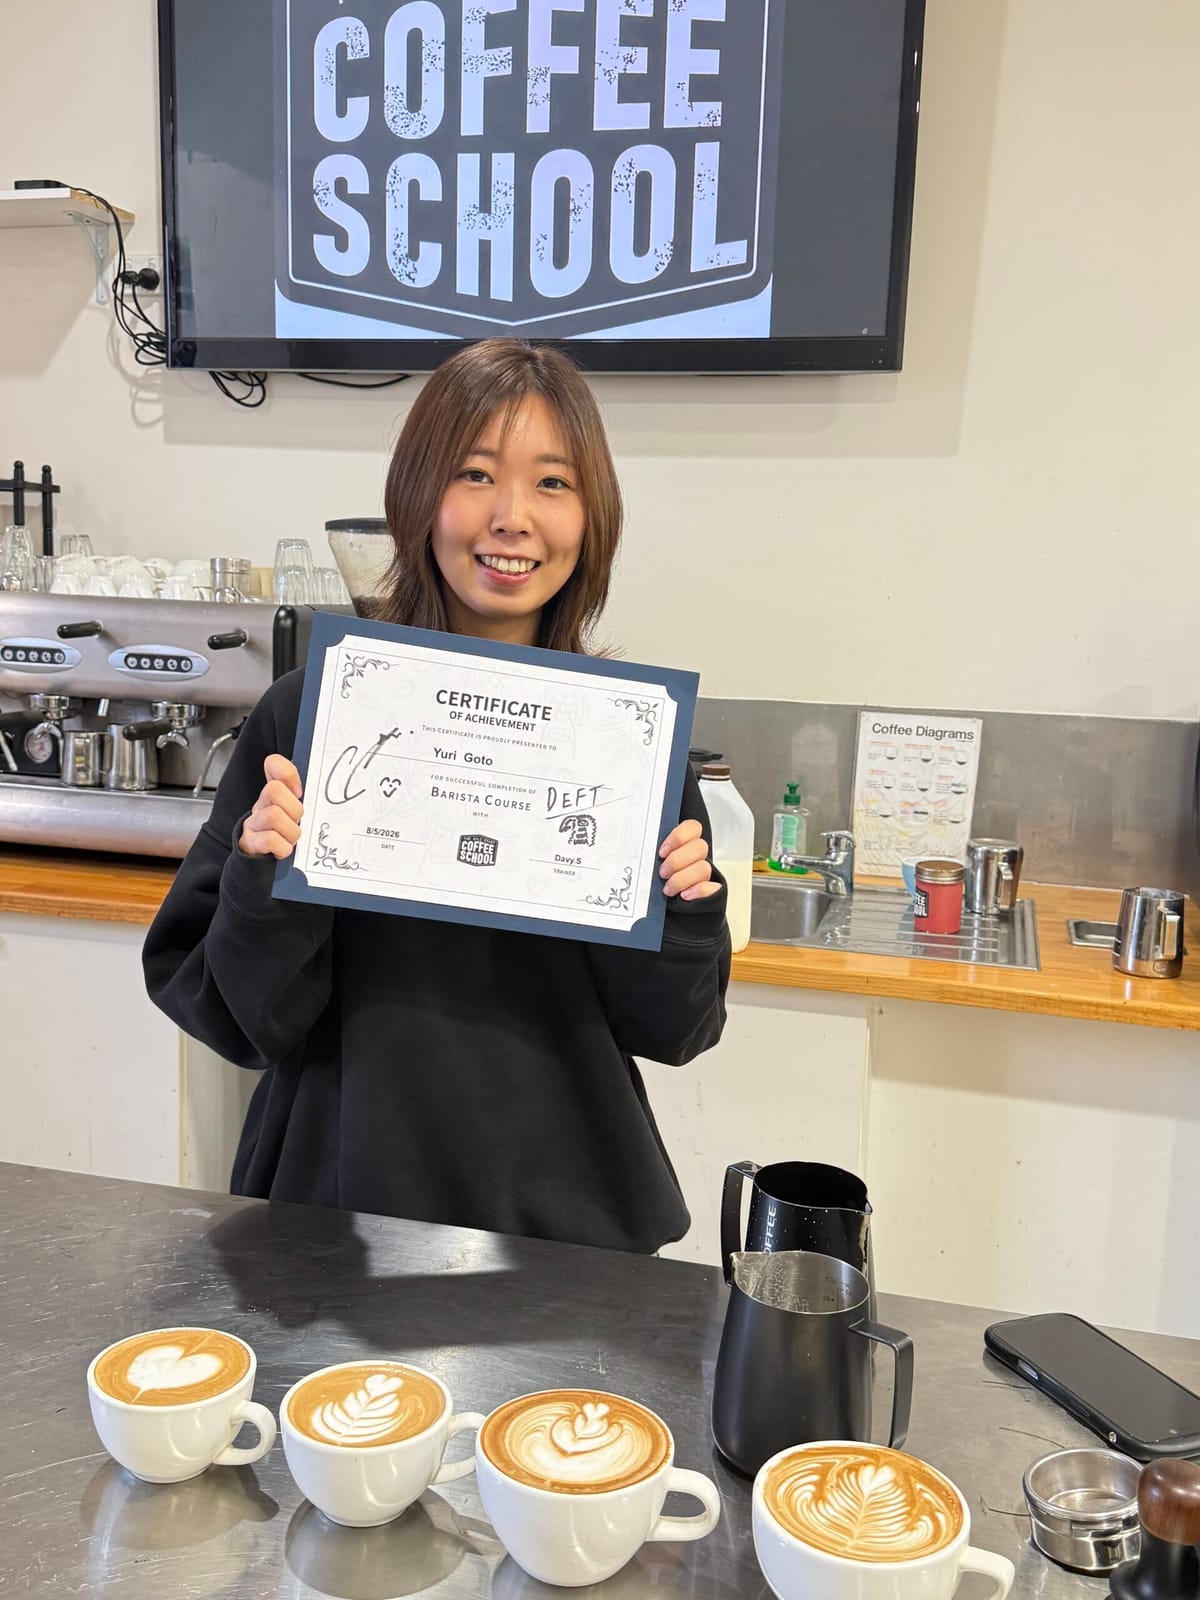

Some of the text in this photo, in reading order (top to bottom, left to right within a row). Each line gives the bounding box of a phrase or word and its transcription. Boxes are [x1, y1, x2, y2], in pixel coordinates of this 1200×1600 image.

[313, 0, 725, 142] COFFEE
[313, 142, 747, 302] SCHOOL
[436, 689, 552, 721] CERTIFICATE
[449, 711, 536, 732] OF ACHIEVEMENT
[872, 722, 975, 741] Coffee Diagrams
[422, 724, 436, 732] THIS
[437, 727, 474, 739] CERTIFICATE
[483, 734, 510, 744] PROUDLY
[512, 740, 547, 750] PRESENTED
[433, 747, 493, 766] Yuri Goto
[445, 776, 486, 788] SUCCESSFUL
[488, 782, 527, 794] COMPLETION
[431, 786, 532, 811] BARISTA COURSE
[547, 784, 605, 812] DEFT
[366, 826, 400, 838] 8/5/2026
[460, 850, 495, 864] SCHOOL
[461, 840, 495, 855] COFFEE
